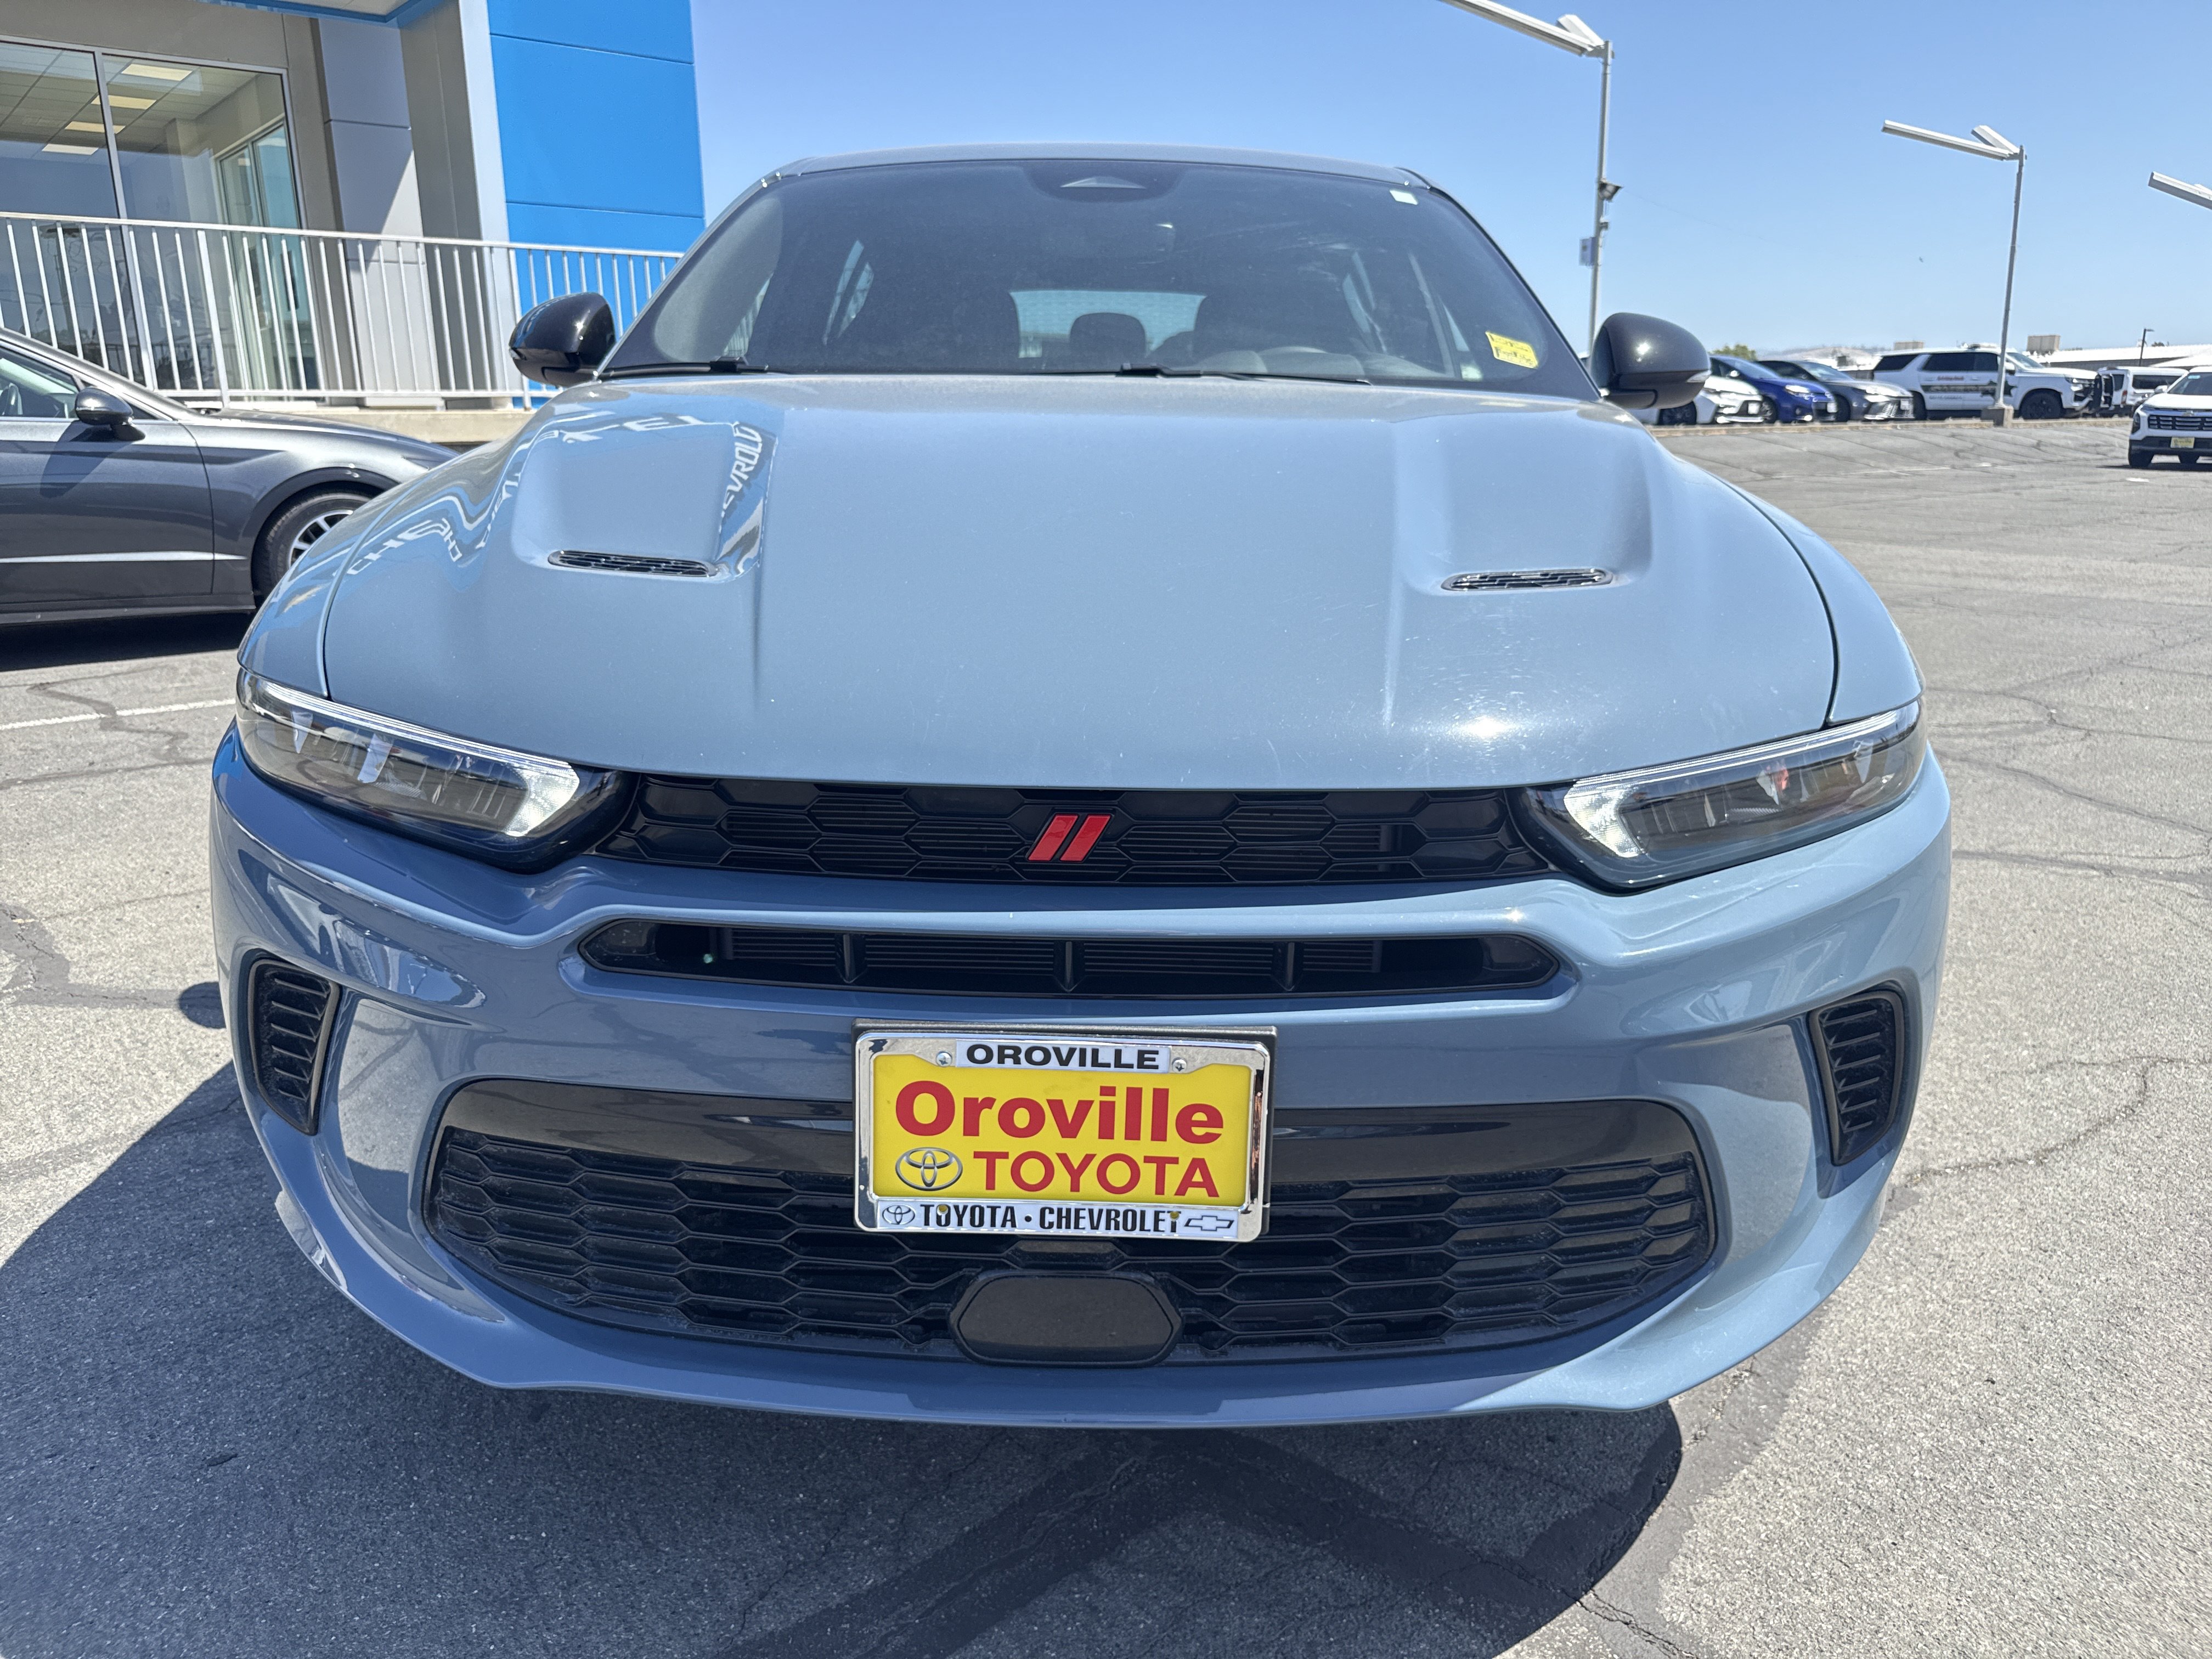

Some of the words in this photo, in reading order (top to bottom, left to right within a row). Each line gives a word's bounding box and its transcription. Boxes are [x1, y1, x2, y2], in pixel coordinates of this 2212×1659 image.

[967, 1044, 1159, 1069] OROVILLE
[896, 1081, 1223, 1144] Oroville
[974, 1151, 1219, 1198] TOYOTA
[920, 1204, 1017, 1228] TOYOTA
[1039, 1206, 1182, 1233] CHEVROLET
